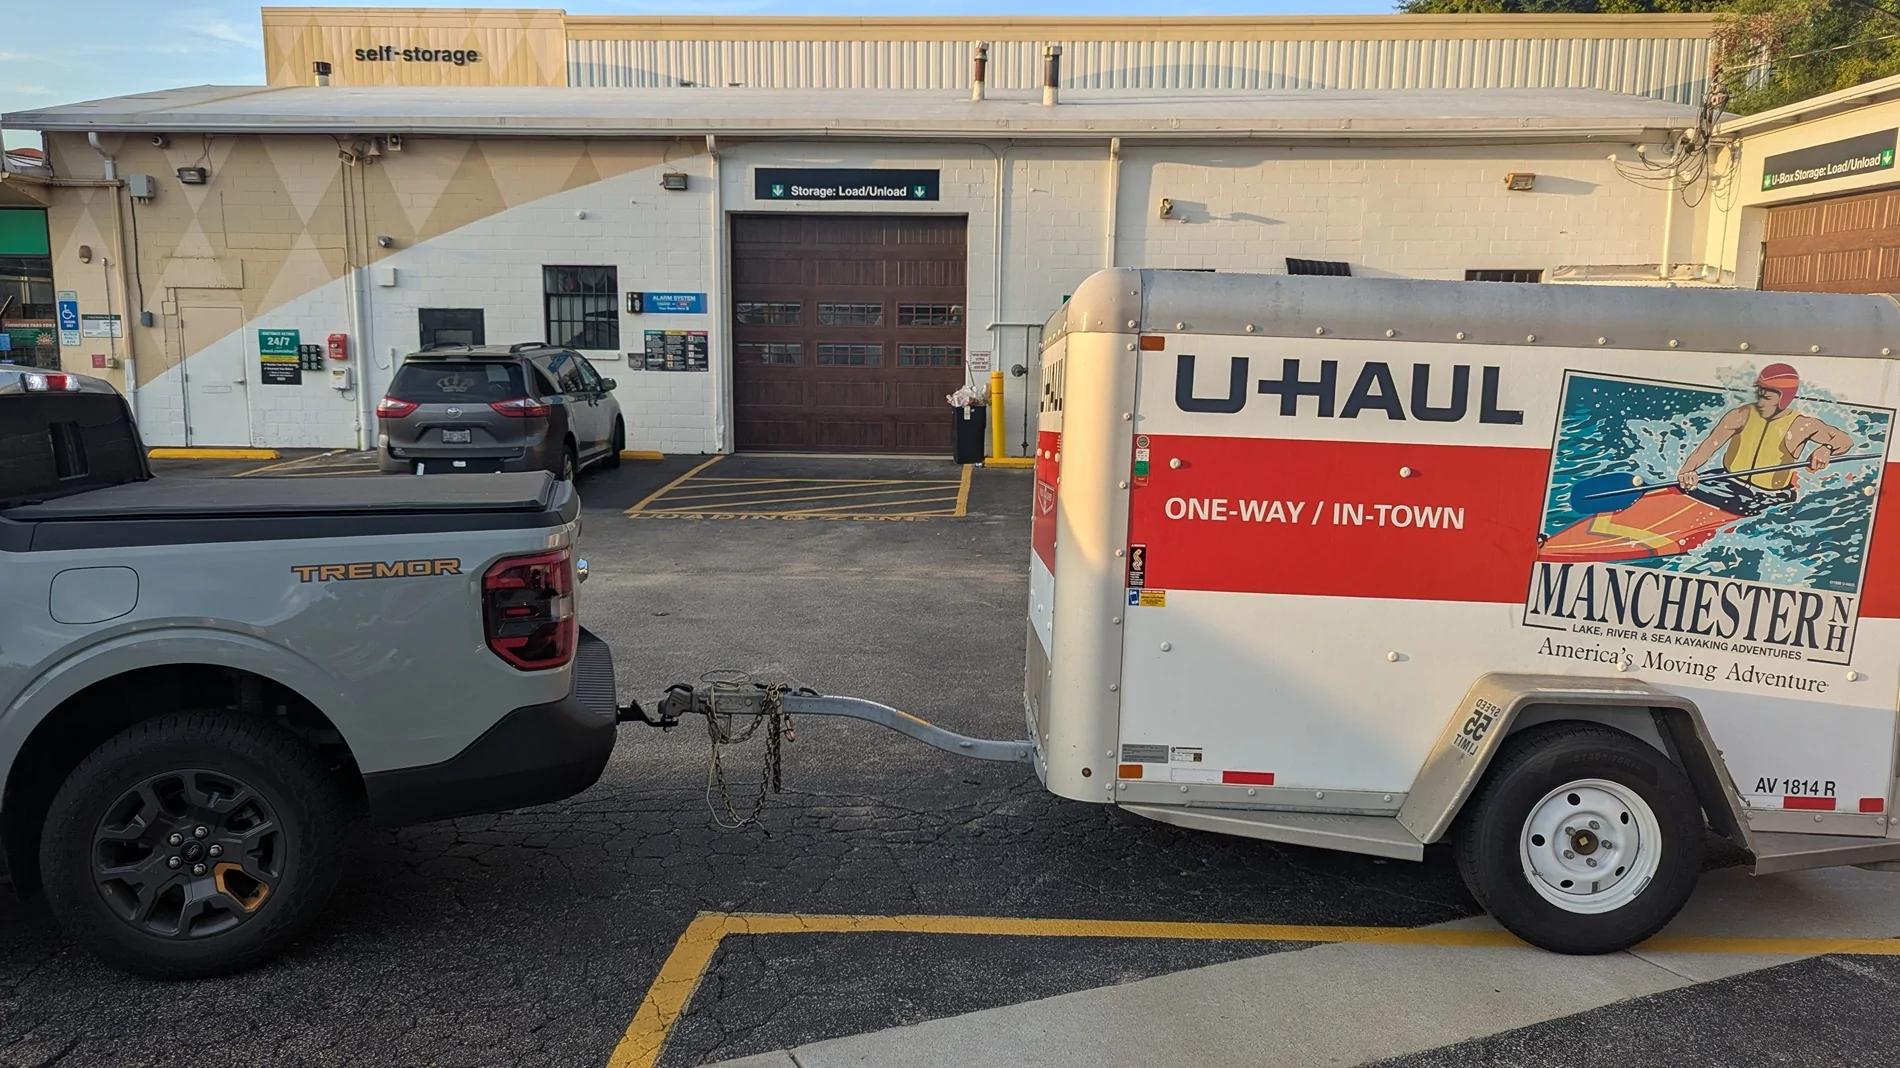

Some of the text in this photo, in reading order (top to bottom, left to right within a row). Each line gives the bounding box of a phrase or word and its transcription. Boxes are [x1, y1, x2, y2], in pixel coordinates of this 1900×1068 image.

[354, 45, 479, 67] self-storage
[1771, 153, 1882, 185] U-Box Storage: Load/Unload
[791, 185, 907, 198] Storage: Load/Unload
[267, 336, 290, 346] 24/7
[1174, 354, 1524, 425] U-HAUL
[1164, 497, 1306, 523] ONE-WAY
[1332, 503, 1465, 530] IN-TOWN
[291, 557, 464, 582] TREMOR
[1530, 562, 1824, 650] MANCHESTER
[1572, 623, 1802, 660] LAKE, RIVER & SEA KAYAKING ADVENTURES
[1537, 636, 1828, 693] America's Moving Adventure
[1754, 777, 1836, 796] AV 1814 R
